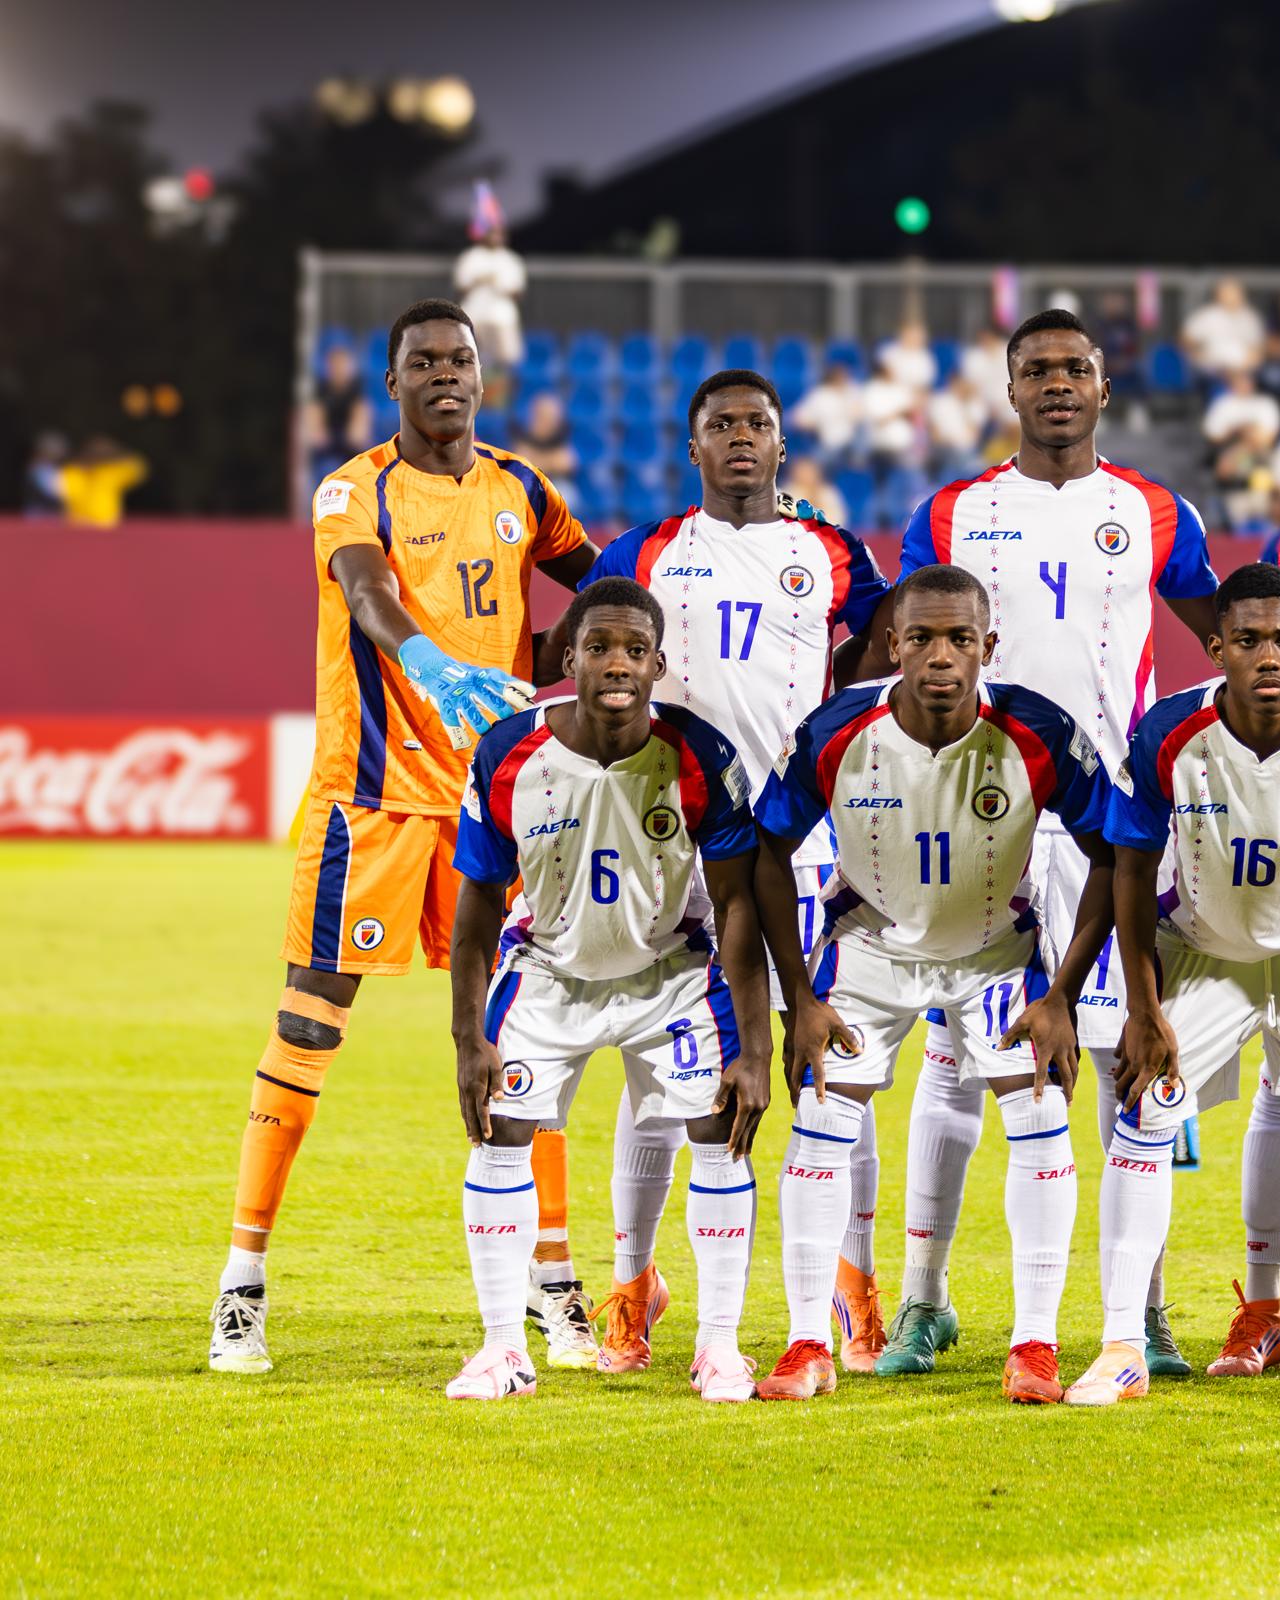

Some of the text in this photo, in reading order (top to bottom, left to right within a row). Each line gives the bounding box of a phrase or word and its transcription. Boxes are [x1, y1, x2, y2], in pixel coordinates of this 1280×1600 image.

[963, 531, 1022, 542] SAETA
[661, 567, 713, 579] SAETA
[457, 558, 498, 619] 12
[1039, 561, 1068, 620] 4
[717, 600, 763, 661] 17
[842, 798, 904, 809] SAETA
[1173, 803, 1229, 815] SAETA
[523, 818, 581, 839] SAETA
[915, 831, 951, 885] 11
[1231, 836, 1278, 887] 16
[591, 849, 619, 904] 6
[797, 895, 815, 956] 7
[983, 982, 1014, 1038] 11
[666, 1017, 699, 1071] 6
[668, 1067, 713, 1080] SAETA
[785, 1164, 834, 1181] SAETA
[1109, 1156, 1158, 1175] SAETA
[467, 1224, 517, 1235] SAETA
[695, 1227, 745, 1238] SAETA
